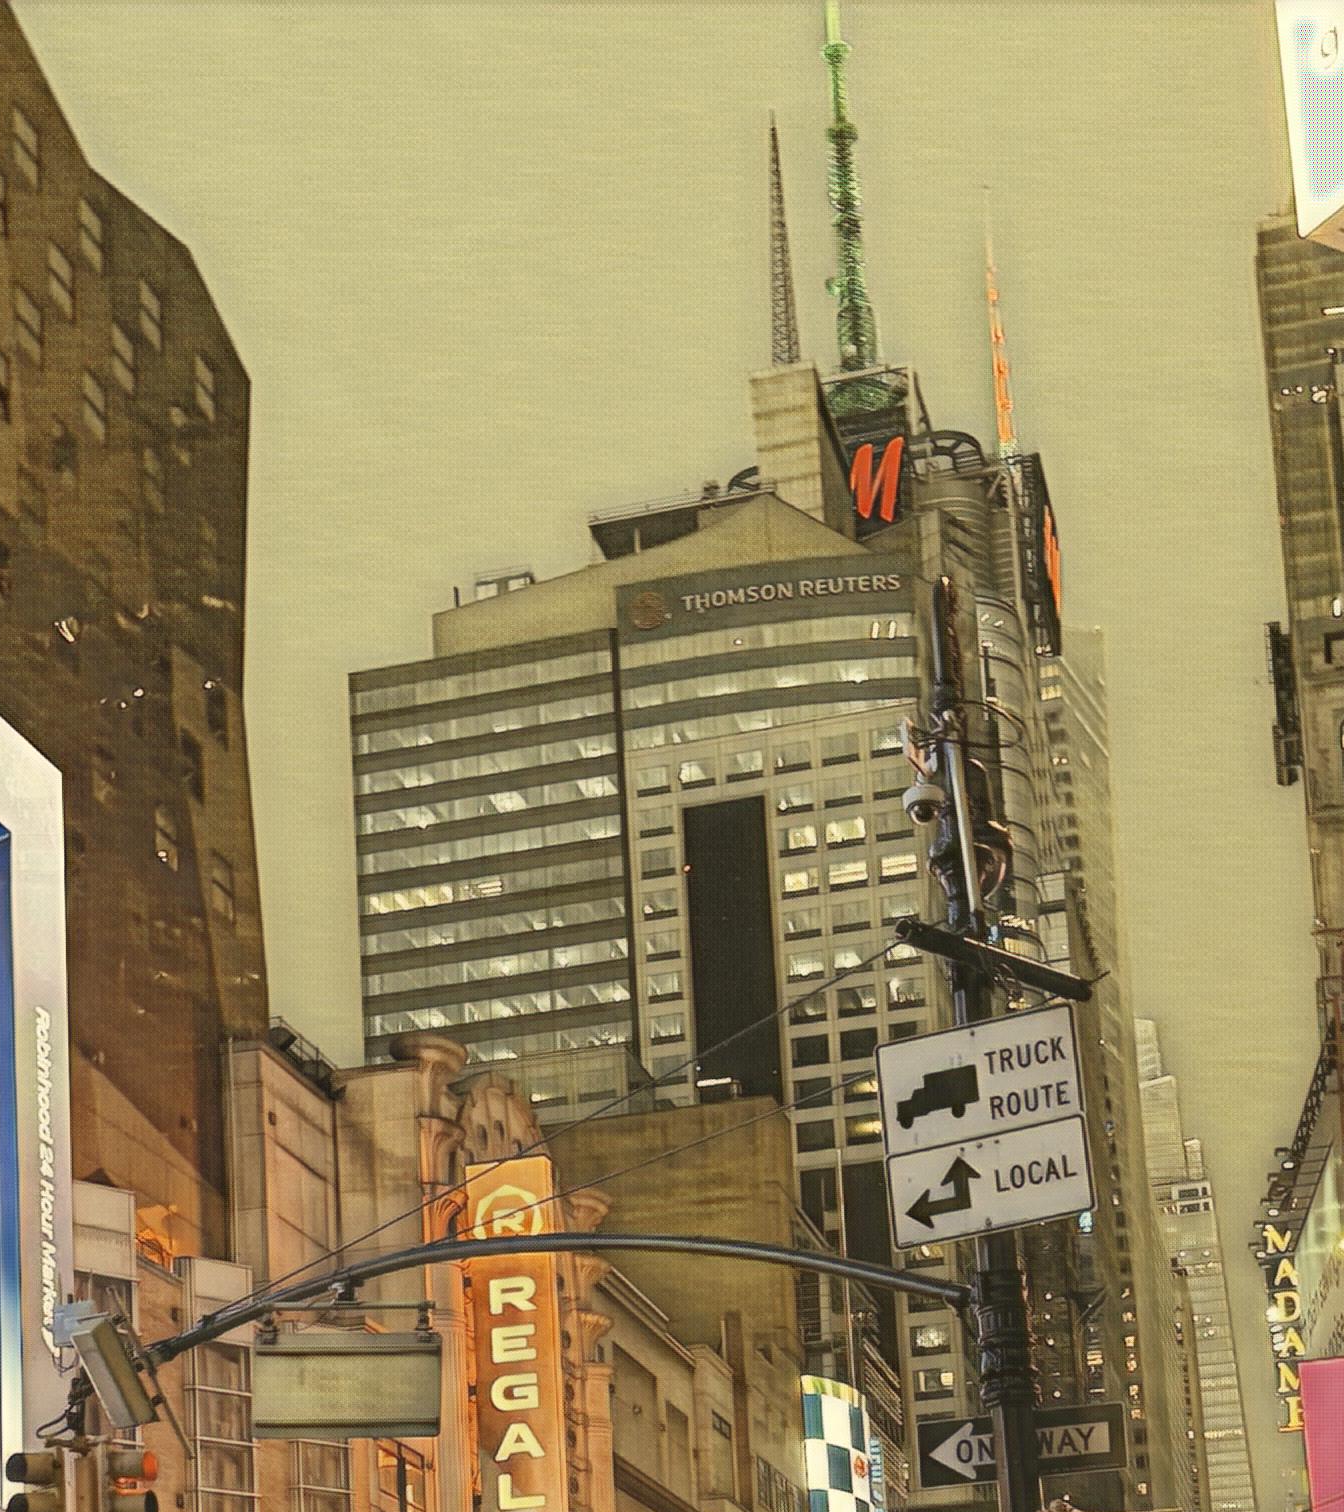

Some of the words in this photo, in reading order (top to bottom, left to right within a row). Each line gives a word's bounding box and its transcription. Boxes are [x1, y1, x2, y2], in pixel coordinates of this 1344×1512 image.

[680, 580, 794, 613] THOMSON
[798, 572, 902, 600] REUTERS
[983, 1034, 1067, 1076] TRUCK
[33, 1005, 56, 1147] Robinhood
[989, 1080, 1072, 1121] ROUTE
[993, 1154, 1079, 1194] LOCAL
[39, 1178, 57, 1248] Hour
[488, 1275, 547, 1512] REGAL
[956, 1438, 994, 1464] ON
[1035, 1425, 1095, 1459] WAY
